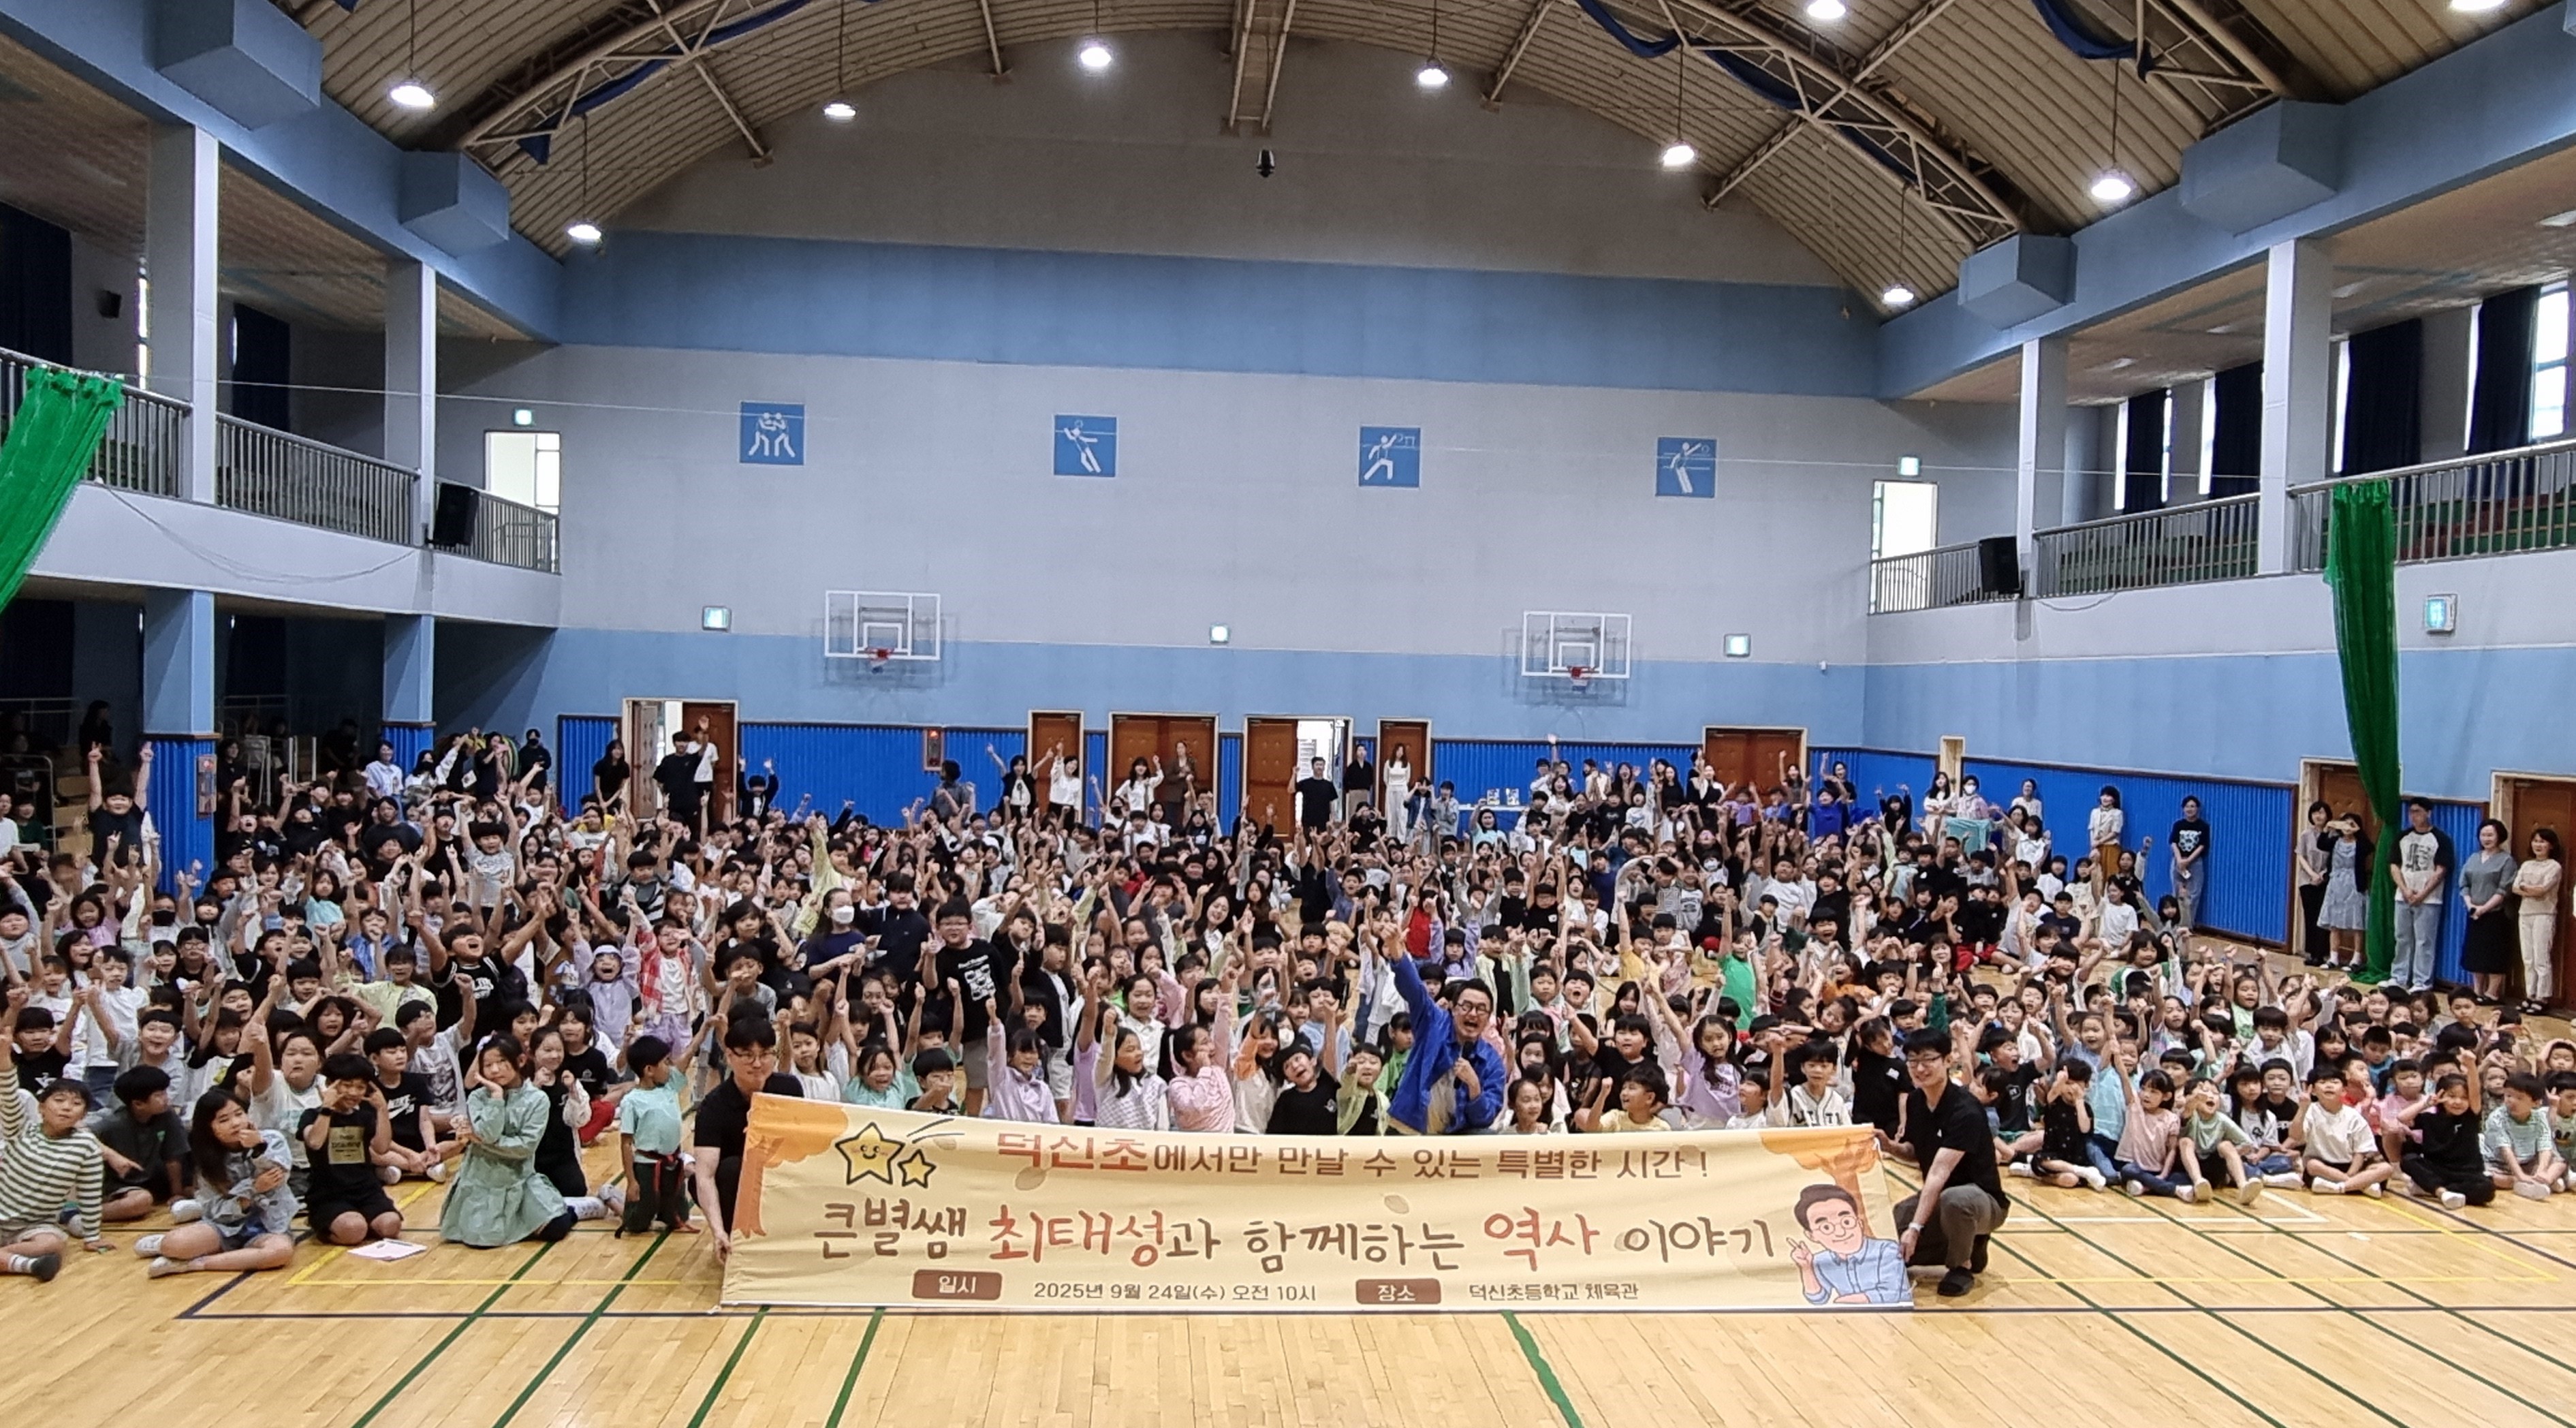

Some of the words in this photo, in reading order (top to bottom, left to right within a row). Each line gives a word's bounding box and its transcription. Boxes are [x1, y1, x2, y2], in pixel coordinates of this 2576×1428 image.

[998, 1133, 1262, 1173] 덕신초에서만
[1278, 1147, 1349, 1175] 만날
[1362, 1148, 1397, 1177] 수
[1413, 1149, 1482, 1179] 있는
[1496, 1149, 1603, 1179] 특별한
[814, 1197, 967, 1259] 큰별쌤
[989, 1204, 1221, 1267] 최태성과
[1243, 1220, 1465, 1273] 함께하는
[1483, 1206, 1600, 1272] 역사
[1624, 1219, 1774, 1263] 이야기
[938, 1274, 977, 1294] 일시
[1033, 1282, 1103, 1299] 2025년
[1110, 1283, 1141, 1299] 9월
[1148, 1284, 1225, 1301] 24일(수)
[1231, 1285, 1270, 1301] 오전
[1278, 1285, 1317, 1301] 10시
[1377, 1284, 1416, 1302] 장소
[1468, 1283, 1580, 1301] 덕신초등학교
[1585, 1282, 1639, 1301] 체육관
